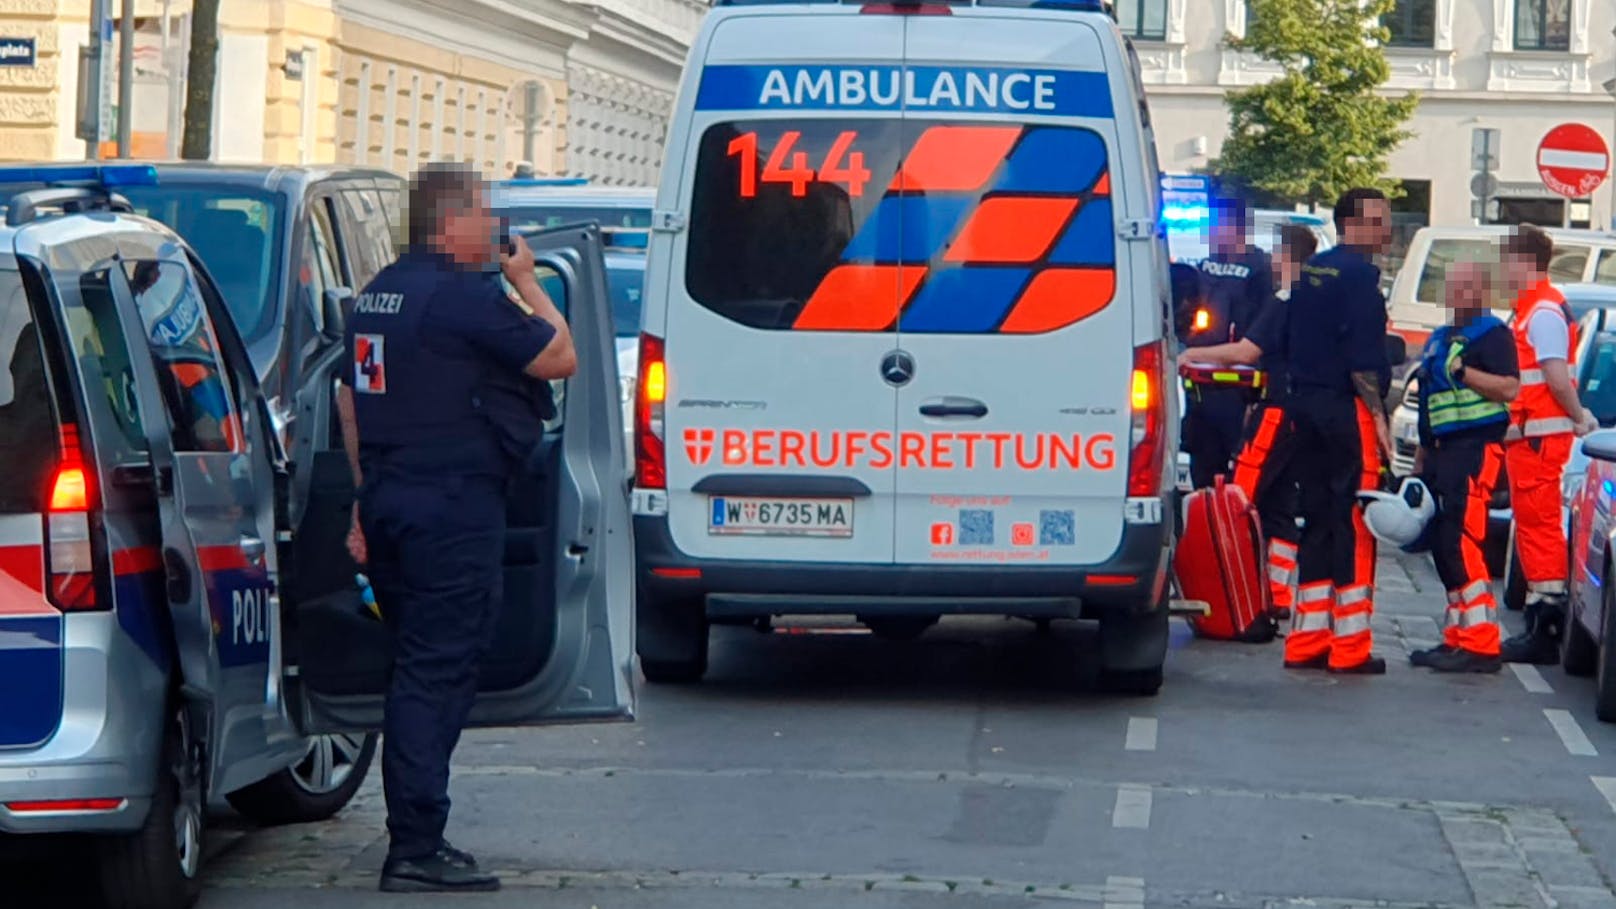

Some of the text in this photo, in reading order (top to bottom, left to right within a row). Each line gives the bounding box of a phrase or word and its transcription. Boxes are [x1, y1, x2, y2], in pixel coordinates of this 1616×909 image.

[759, 69, 1056, 110] AMBULANCE
[727, 130, 872, 197] 144
[1202, 260, 1250, 278] POLIZEI
[353, 293, 404, 314] POLIZEI
[361, 341, 377, 384] 4
[722, 429, 1116, 470] BERUFSRETTUNG
[727, 502, 846, 525] W 6735 MA
[232, 587, 269, 645] POLI
